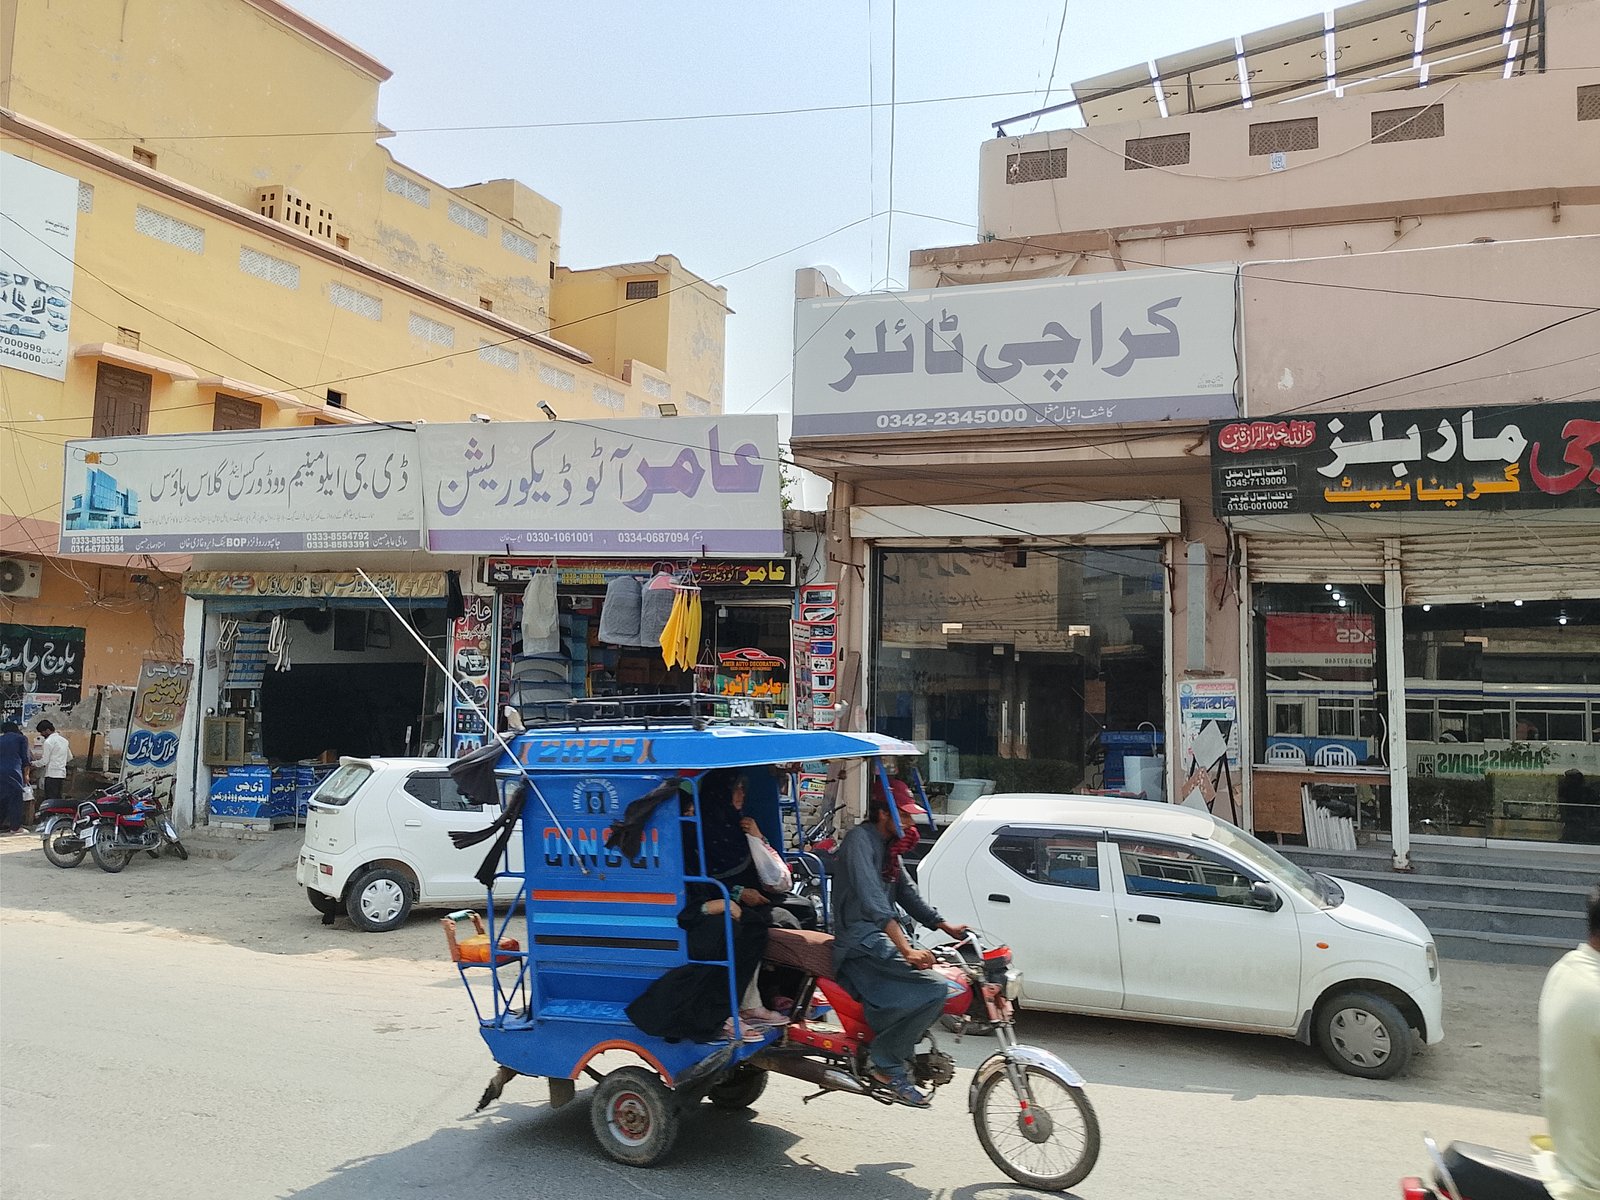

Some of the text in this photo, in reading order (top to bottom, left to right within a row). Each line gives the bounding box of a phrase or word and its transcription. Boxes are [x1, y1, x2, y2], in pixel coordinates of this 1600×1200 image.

[828, 297, 1182, 393] کراچی ٹائلز
[876, 404, 1117, 428] کاشف اقبال مغل 0342-2345000
[1317, 410, 1528, 478] ماربلز
[187, 457, 228, 502] گلاس
[343, 453, 368, 500] جی
[372, 453, 409, 499] ڈی
[437, 425, 764, 517] عامر آٹو ڈیکوریشن
[1225, 477, 1287, 487] 0345-7139009
[150, 468, 186, 507] ہاؤس
[71, 536, 124, 545] 0333-8583391
[226, 537, 247, 547] BOP
[307, 532, 369, 541] 0333-8554792
[307, 541, 369, 549] 0333-8583391
[526, 533, 594, 542] 0330-1061001
[618, 532, 689, 542] 0334-0687094
[740, 561, 786, 586] عامر
[458, 598, 491, 624] عامر
[40, 642, 76, 675] بلوچ
[751, 677, 782, 697] عامر
